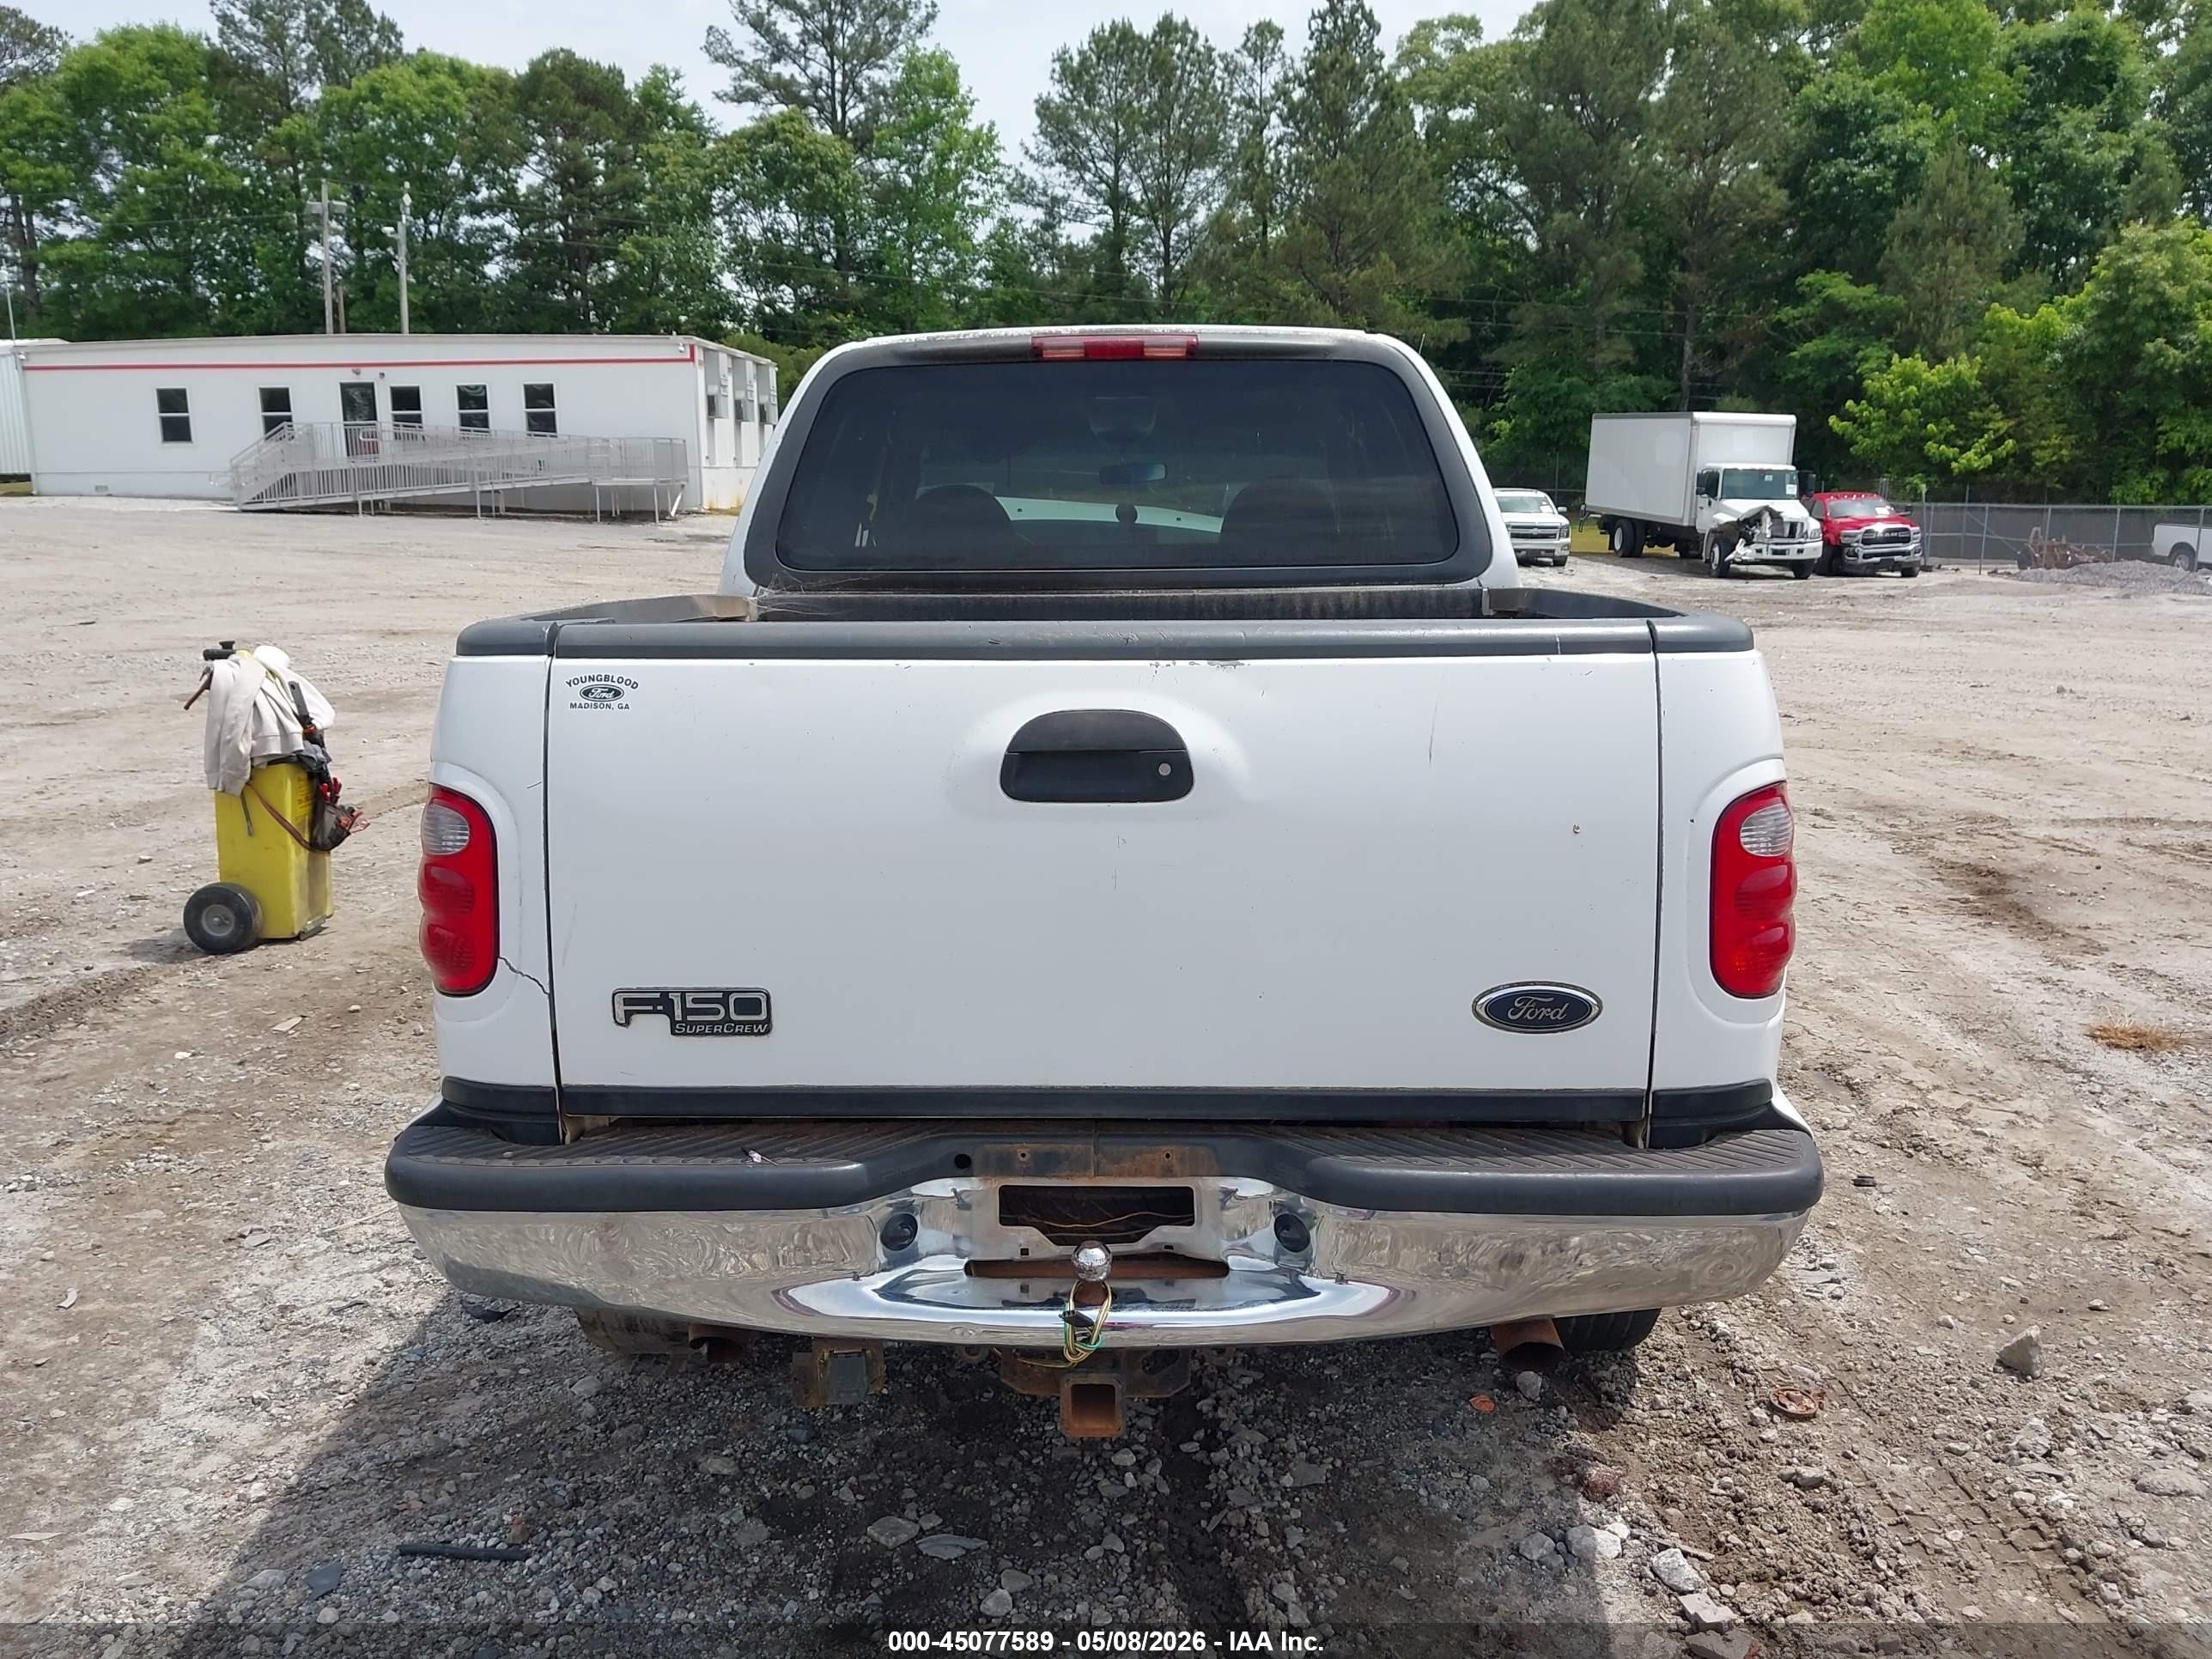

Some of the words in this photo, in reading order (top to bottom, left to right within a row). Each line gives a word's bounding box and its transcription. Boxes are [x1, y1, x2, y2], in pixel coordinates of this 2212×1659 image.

[565, 674, 639, 690] YOUNGBLOOD
[588, 688, 615, 699] Ford
[614, 992, 768, 1024] F-150
[1507, 995, 1570, 1020] Ford
